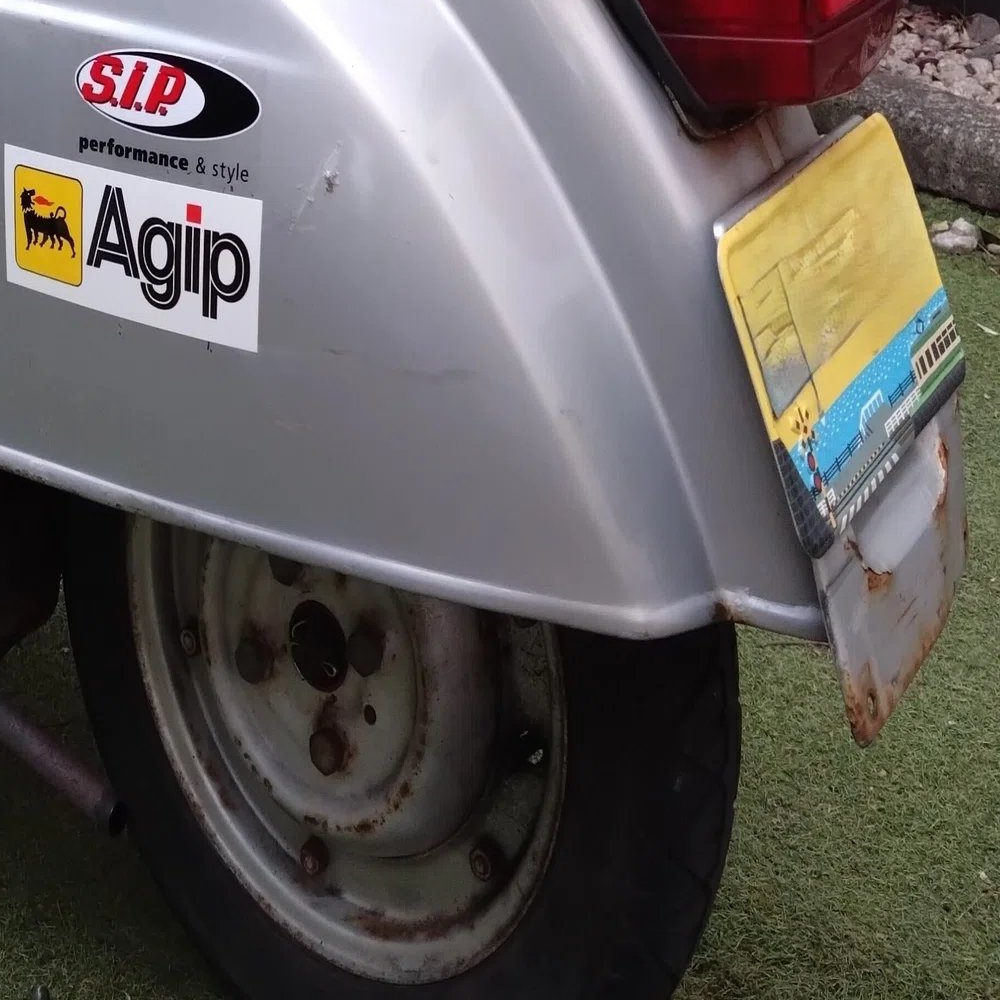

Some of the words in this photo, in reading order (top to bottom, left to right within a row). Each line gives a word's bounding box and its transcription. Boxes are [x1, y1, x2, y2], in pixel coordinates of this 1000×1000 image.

[79, 136, 189, 171] performance
[195, 156, 206, 175] &
[212, 161, 249, 184] style
[86, 184, 251, 320] Agip
